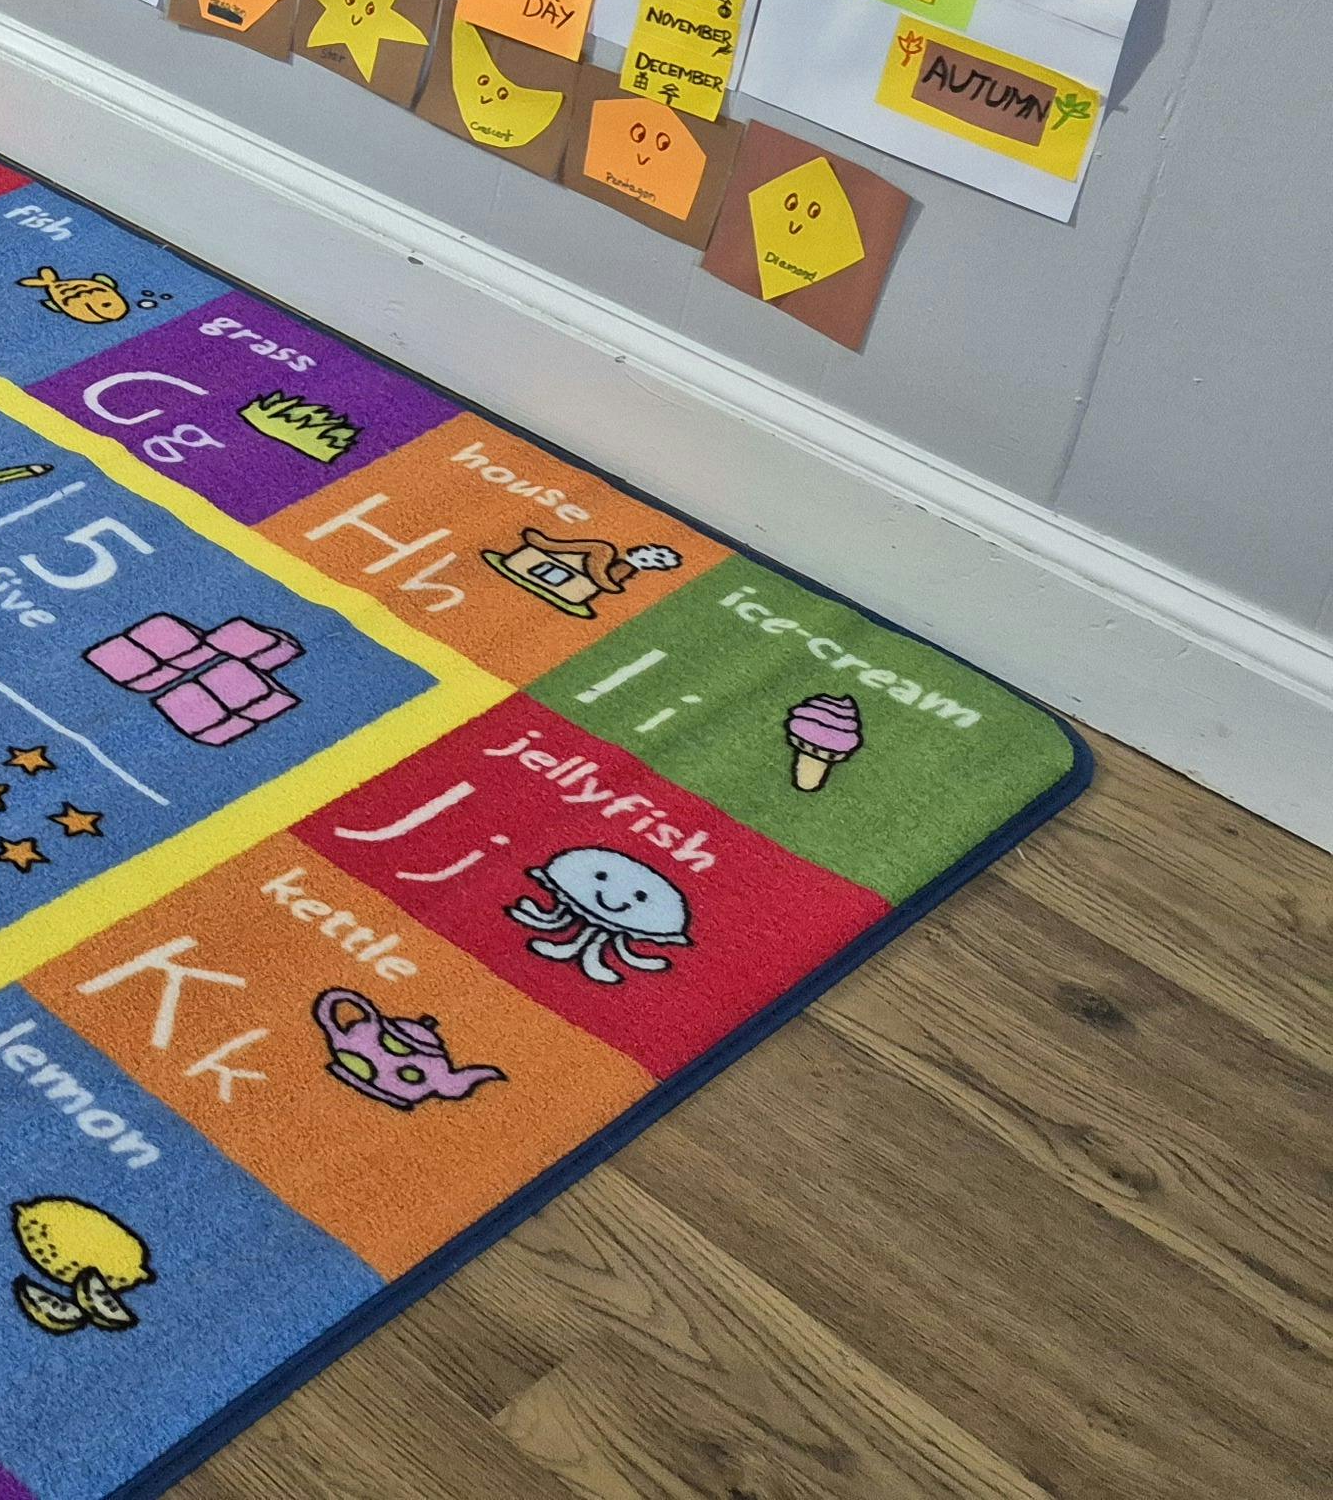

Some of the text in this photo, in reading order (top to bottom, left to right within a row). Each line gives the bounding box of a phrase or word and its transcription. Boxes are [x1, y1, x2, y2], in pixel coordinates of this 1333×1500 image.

[645, 7, 733, 45] NOVEMBER
[635, 52, 724, 92] DECEMBER
[921, 56, 1051, 124] AUTUMN
[2, 205, 74, 242] fish
[198, 315, 318, 373] grass
[449, 441, 591, 526] house
[484, 729, 718, 874] jellyfish
[261, 868, 420, 983] kettle
